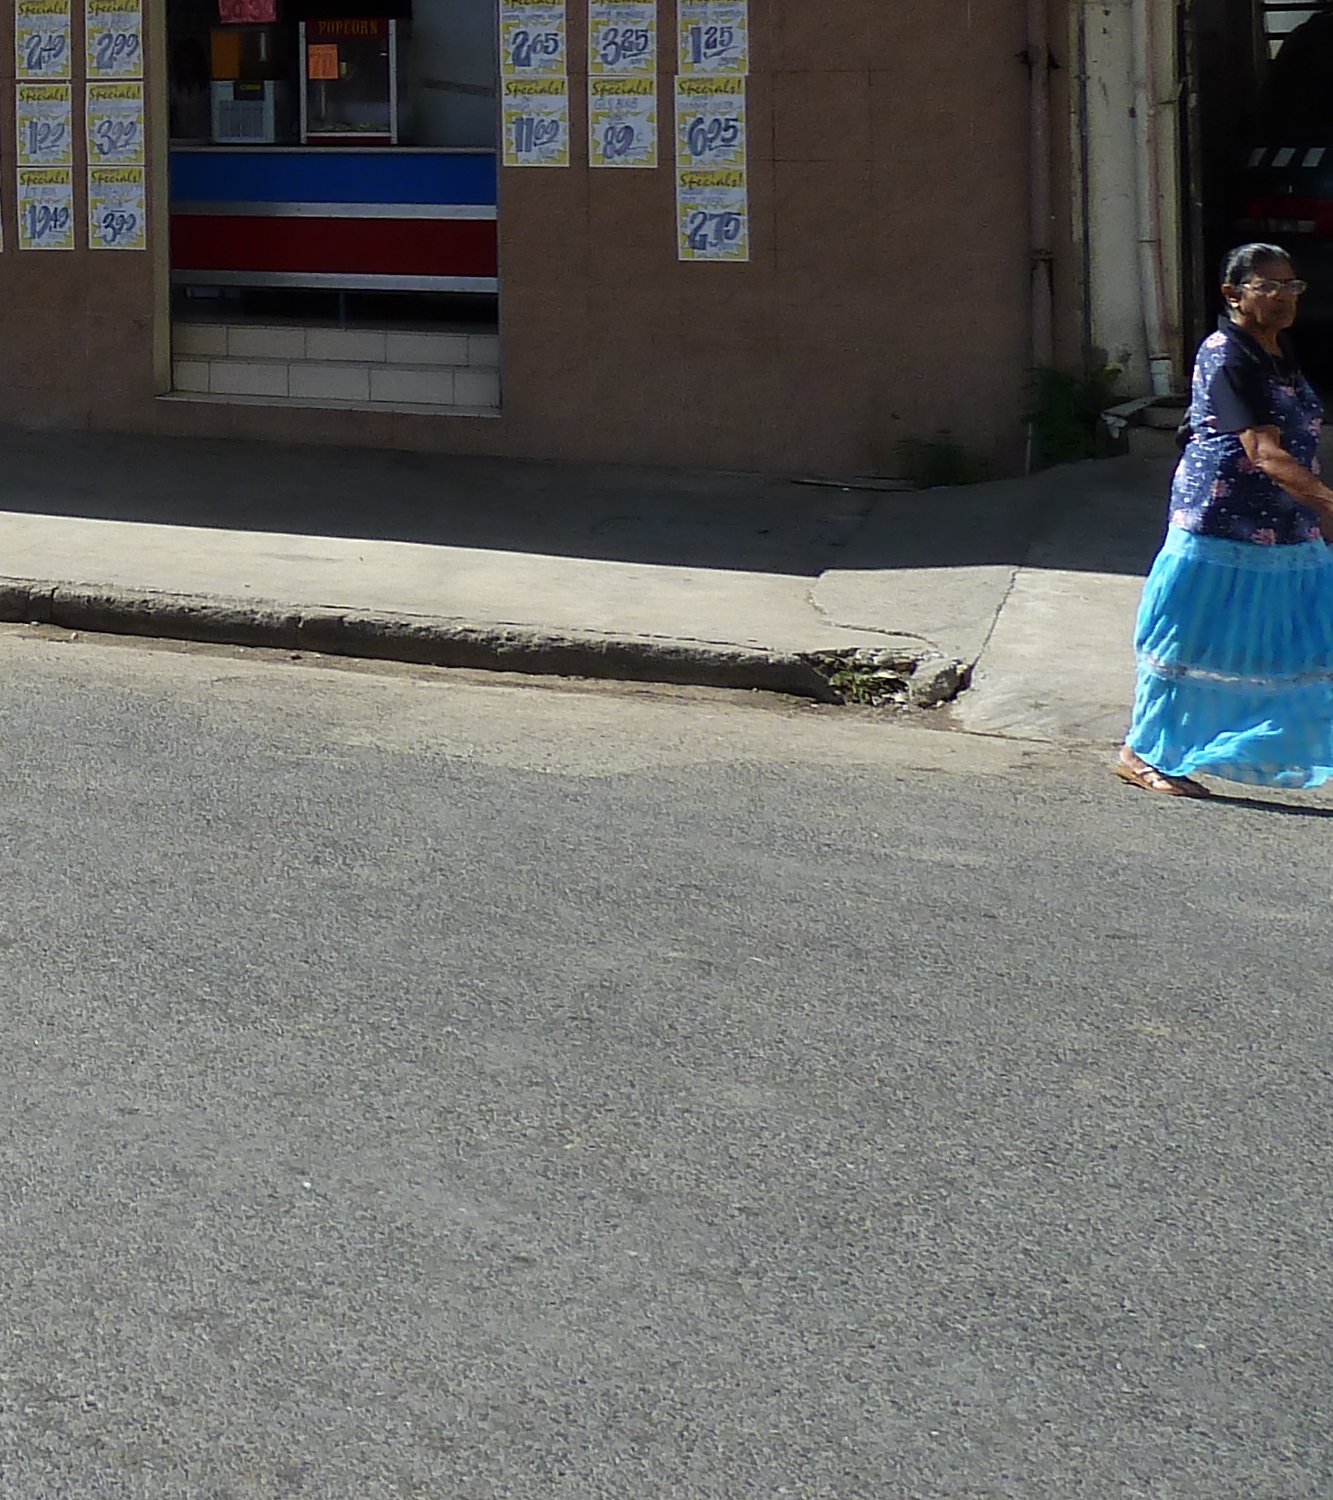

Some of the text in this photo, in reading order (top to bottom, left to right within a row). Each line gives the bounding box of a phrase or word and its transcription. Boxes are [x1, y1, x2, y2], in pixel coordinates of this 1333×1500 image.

[17, 1, 68, 16] Specials!
[87, 0, 140, 15] Specials!
[318, 20, 379, 36] POPCORN
[18, 87, 69, 102] Specials!
[89, 84, 141, 100] Specials!
[505, 81, 565, 99] Specials!
[591, 80, 654, 98] Specials!
[677, 78, 742, 98] Specials!
[20, 170, 69, 186] Specials!
[90, 170, 142, 185] Specials!
[679, 172, 744, 190] Specials!
